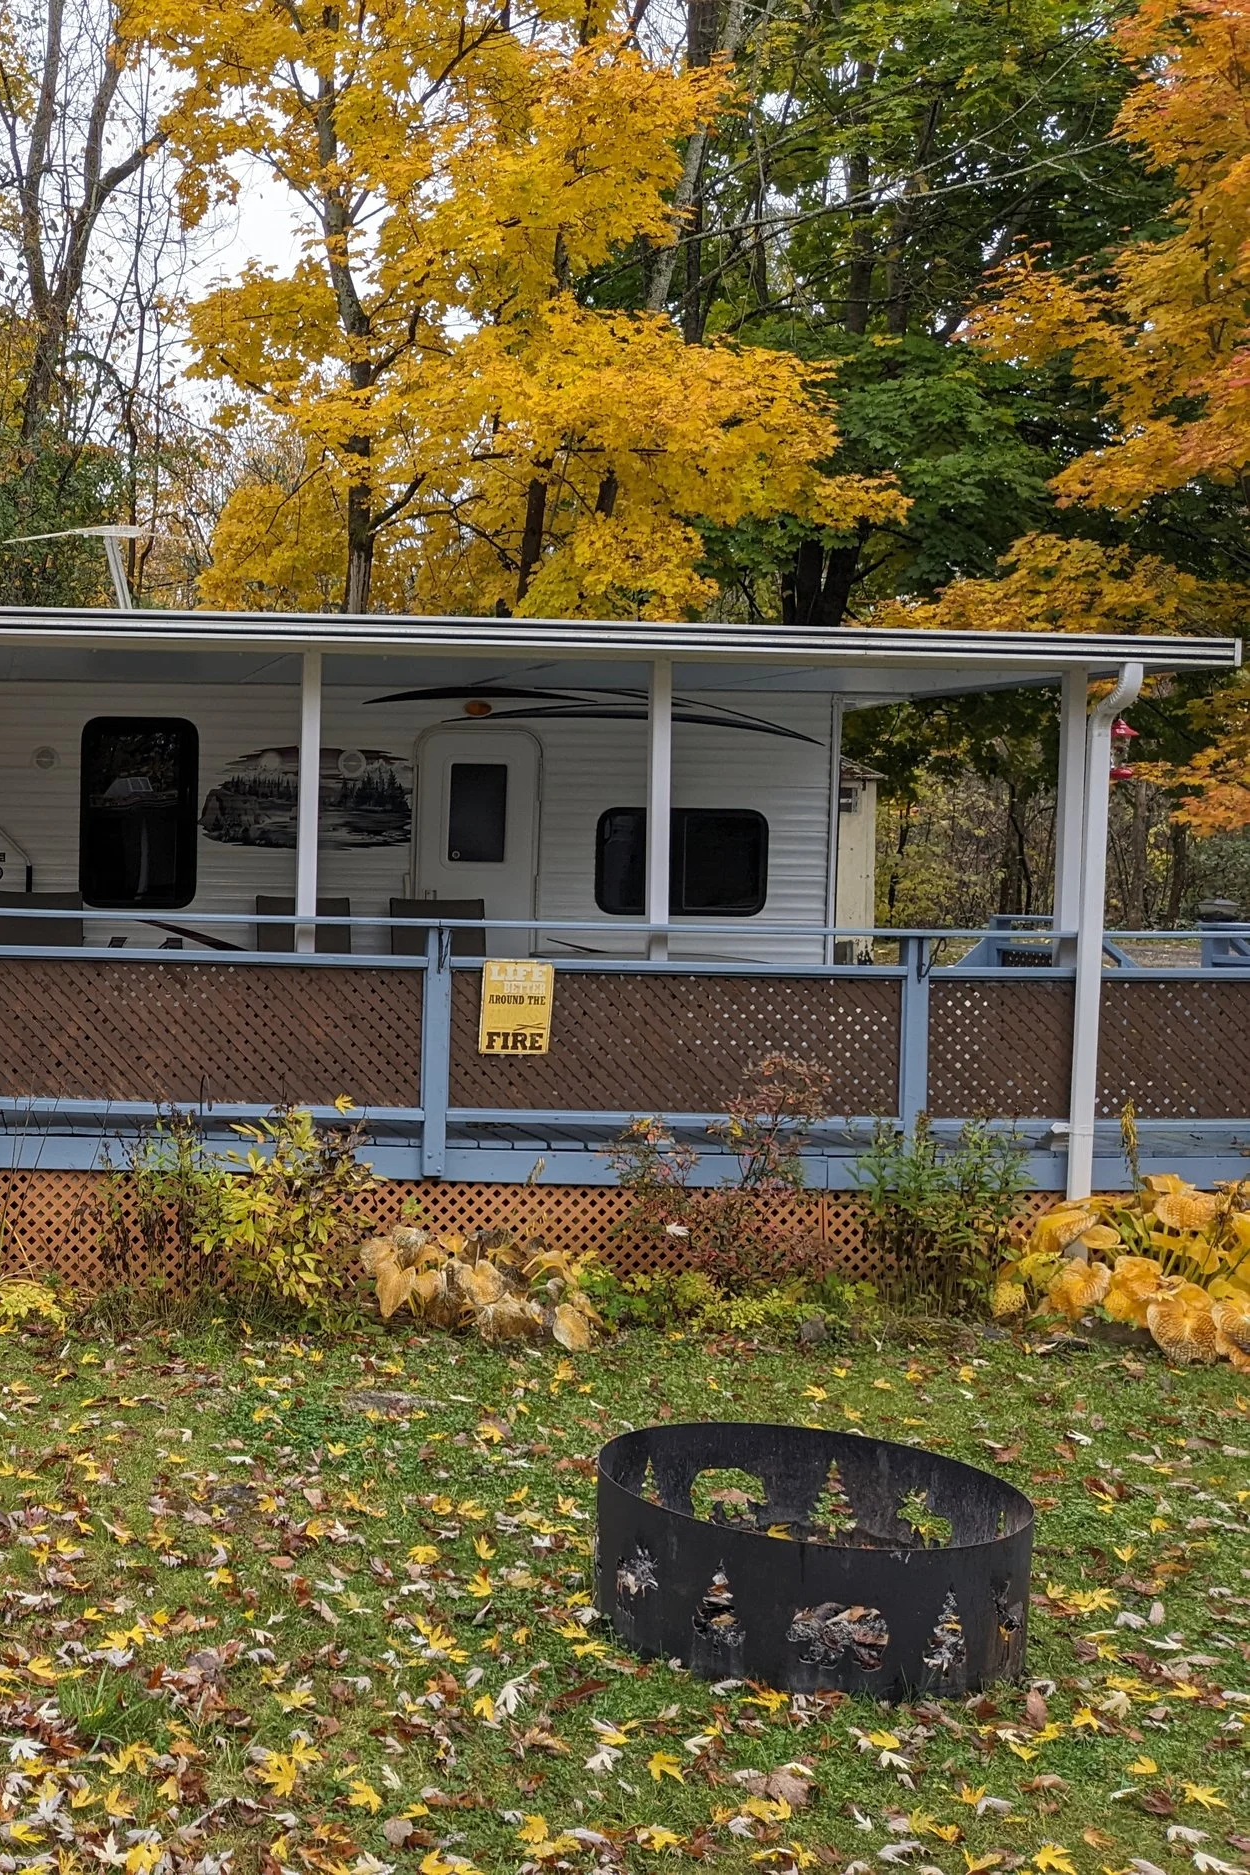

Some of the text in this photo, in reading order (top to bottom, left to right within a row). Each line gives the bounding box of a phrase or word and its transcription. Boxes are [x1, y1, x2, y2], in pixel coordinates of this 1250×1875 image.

[490, 965, 547, 981] LIFE
[504, 981, 546, 994] BETTER
[488, 994, 546, 1006] AROUND THE
[485, 1031, 544, 1051] FIRE
